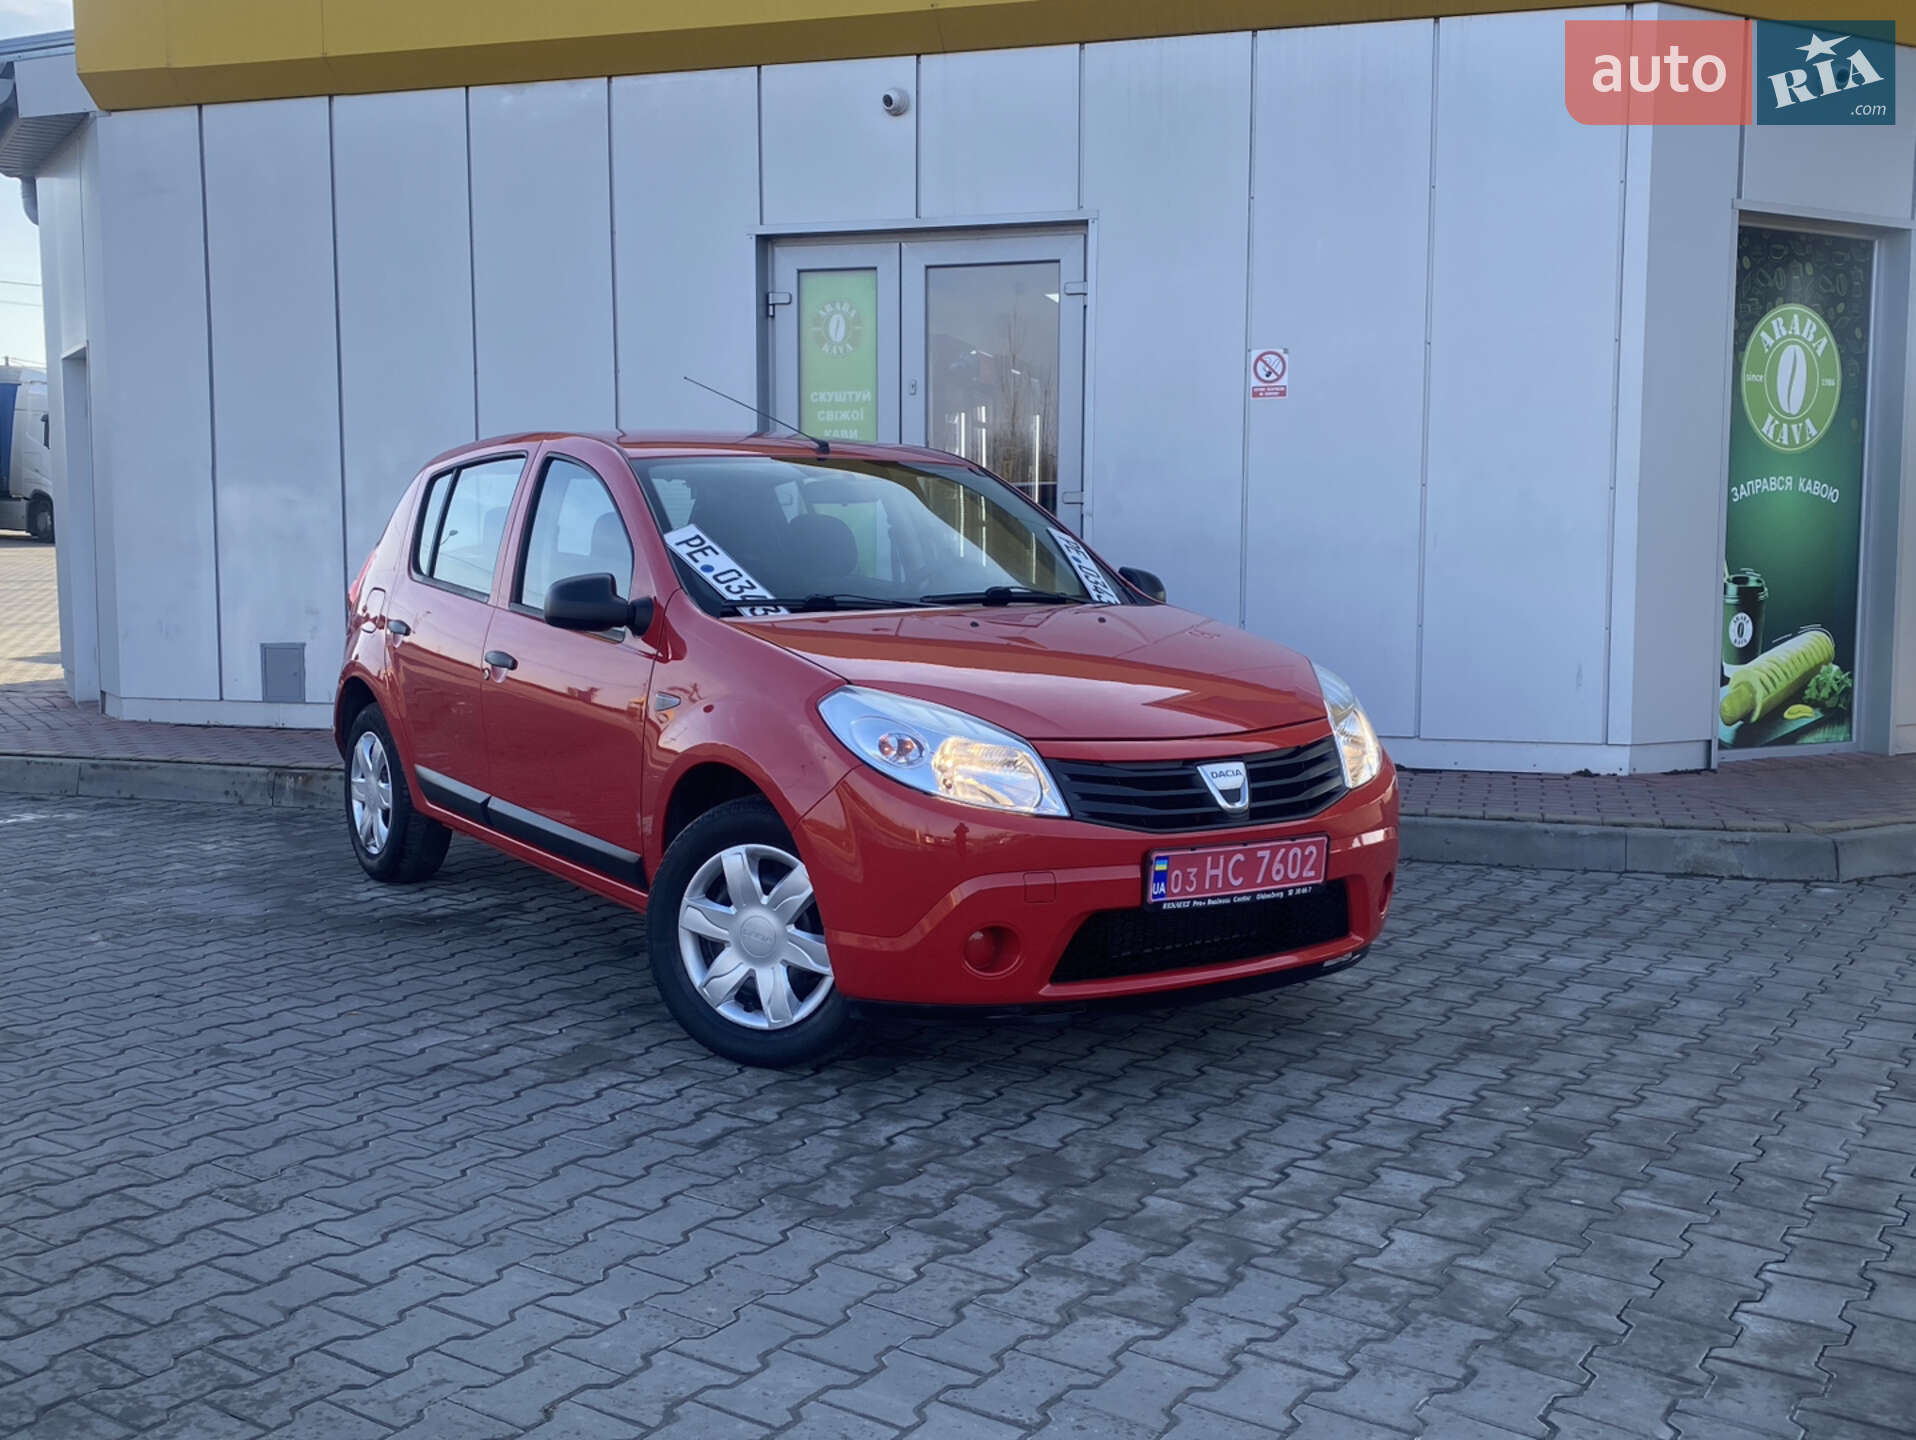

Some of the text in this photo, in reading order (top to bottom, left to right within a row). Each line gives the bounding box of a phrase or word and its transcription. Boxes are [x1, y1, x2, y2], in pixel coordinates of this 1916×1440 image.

[1759, 313, 1829, 357] ARABA
[1761, 412, 1818, 446] KAVA
[1730, 476, 1840, 504] ЗАПРАВСЯ КАВОЮ
[1210, 768, 1242, 779] DACIA
[1170, 845, 1318, 894] 03 HC 7602
[1152, 882, 1167, 895] UA
